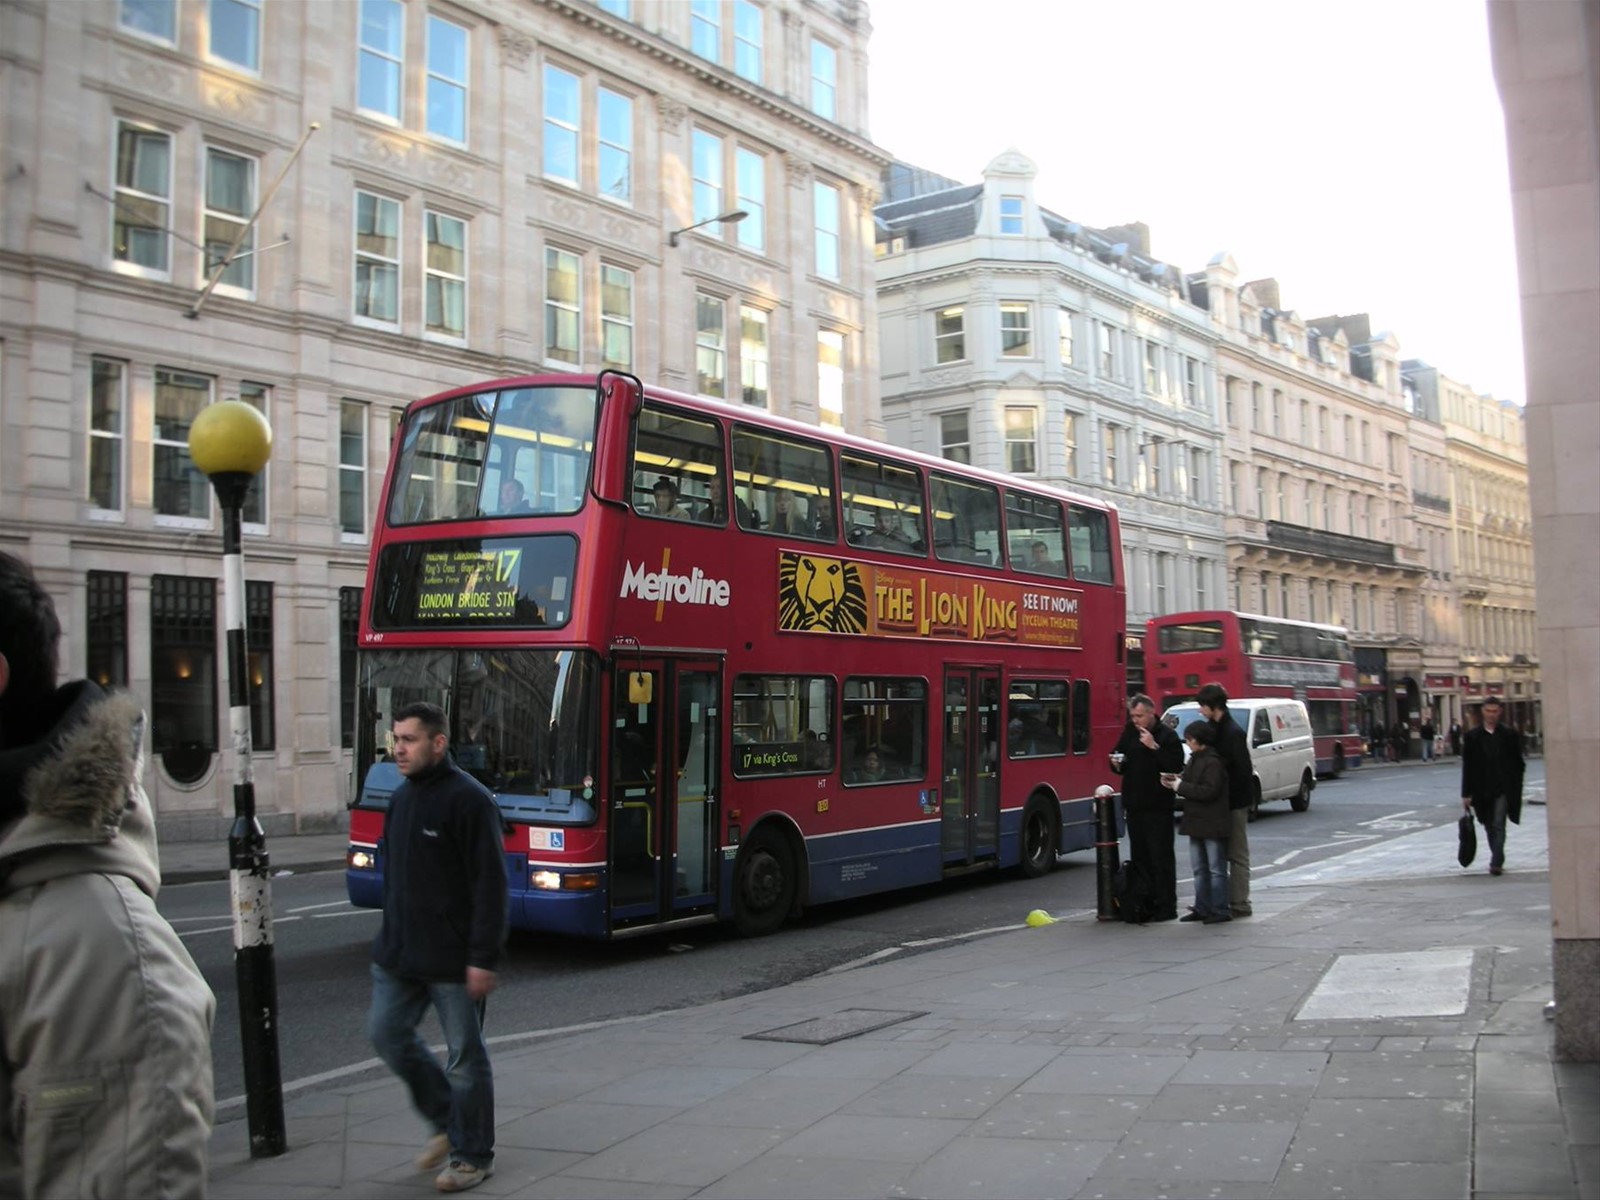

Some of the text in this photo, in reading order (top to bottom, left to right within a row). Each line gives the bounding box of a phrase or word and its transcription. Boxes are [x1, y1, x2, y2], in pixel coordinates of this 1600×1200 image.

[495, 549, 521, 583] 17
[619, 559, 731, 607] Metroline
[419, 591, 516, 608] LONDON BRIDGE STN
[875, 577, 1018, 639] THE LION KING
[1023, 593, 1078, 614] SEE IT NOW!
[1050, 616, 1078, 630] THEATRE
[743, 751, 798, 768] 17 via King's Cross
